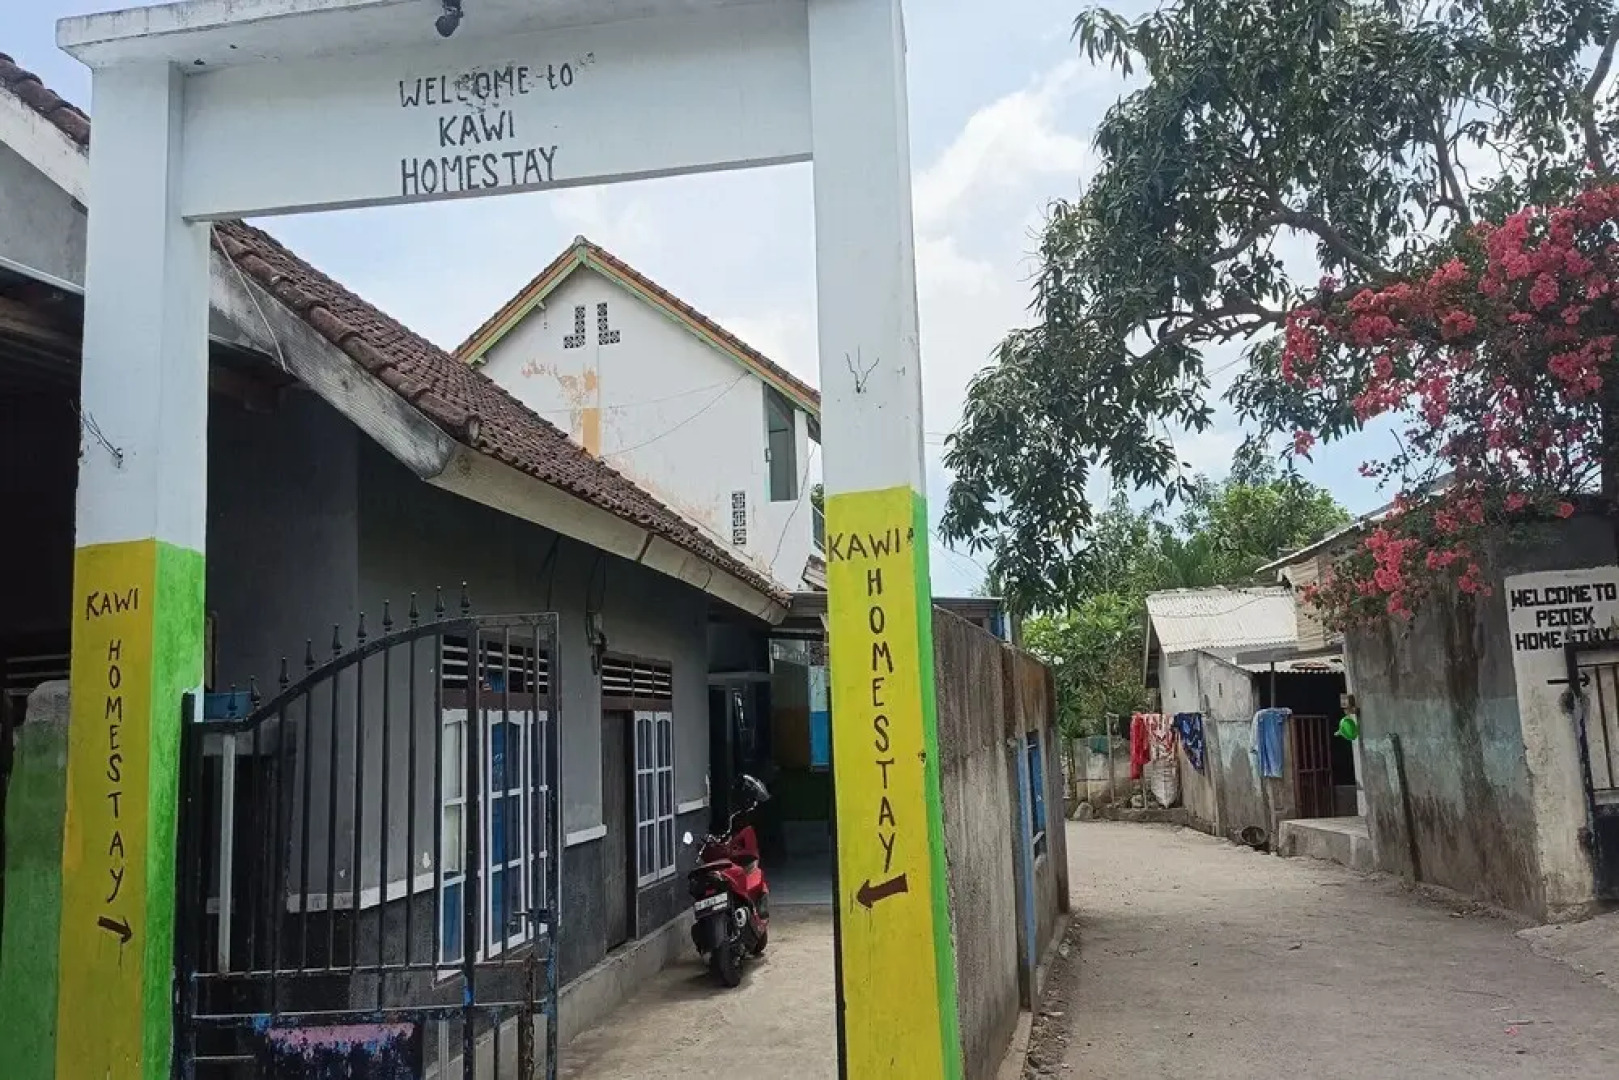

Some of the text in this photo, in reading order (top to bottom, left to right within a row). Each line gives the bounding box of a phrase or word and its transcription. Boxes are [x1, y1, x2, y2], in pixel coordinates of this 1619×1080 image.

[399, 65, 529, 107] WELCOME
[439, 110, 515, 147] KAWI
[401, 146, 558, 196] HOMESTAY
[827, 527, 900, 563] KAWI
[85, 588, 140, 621] KAWI
[1510, 583, 1616, 609] WELCOME TO
[866, 567, 896, 874] HOMESTAY
[105, 639, 125, 904] HOMESTAY
